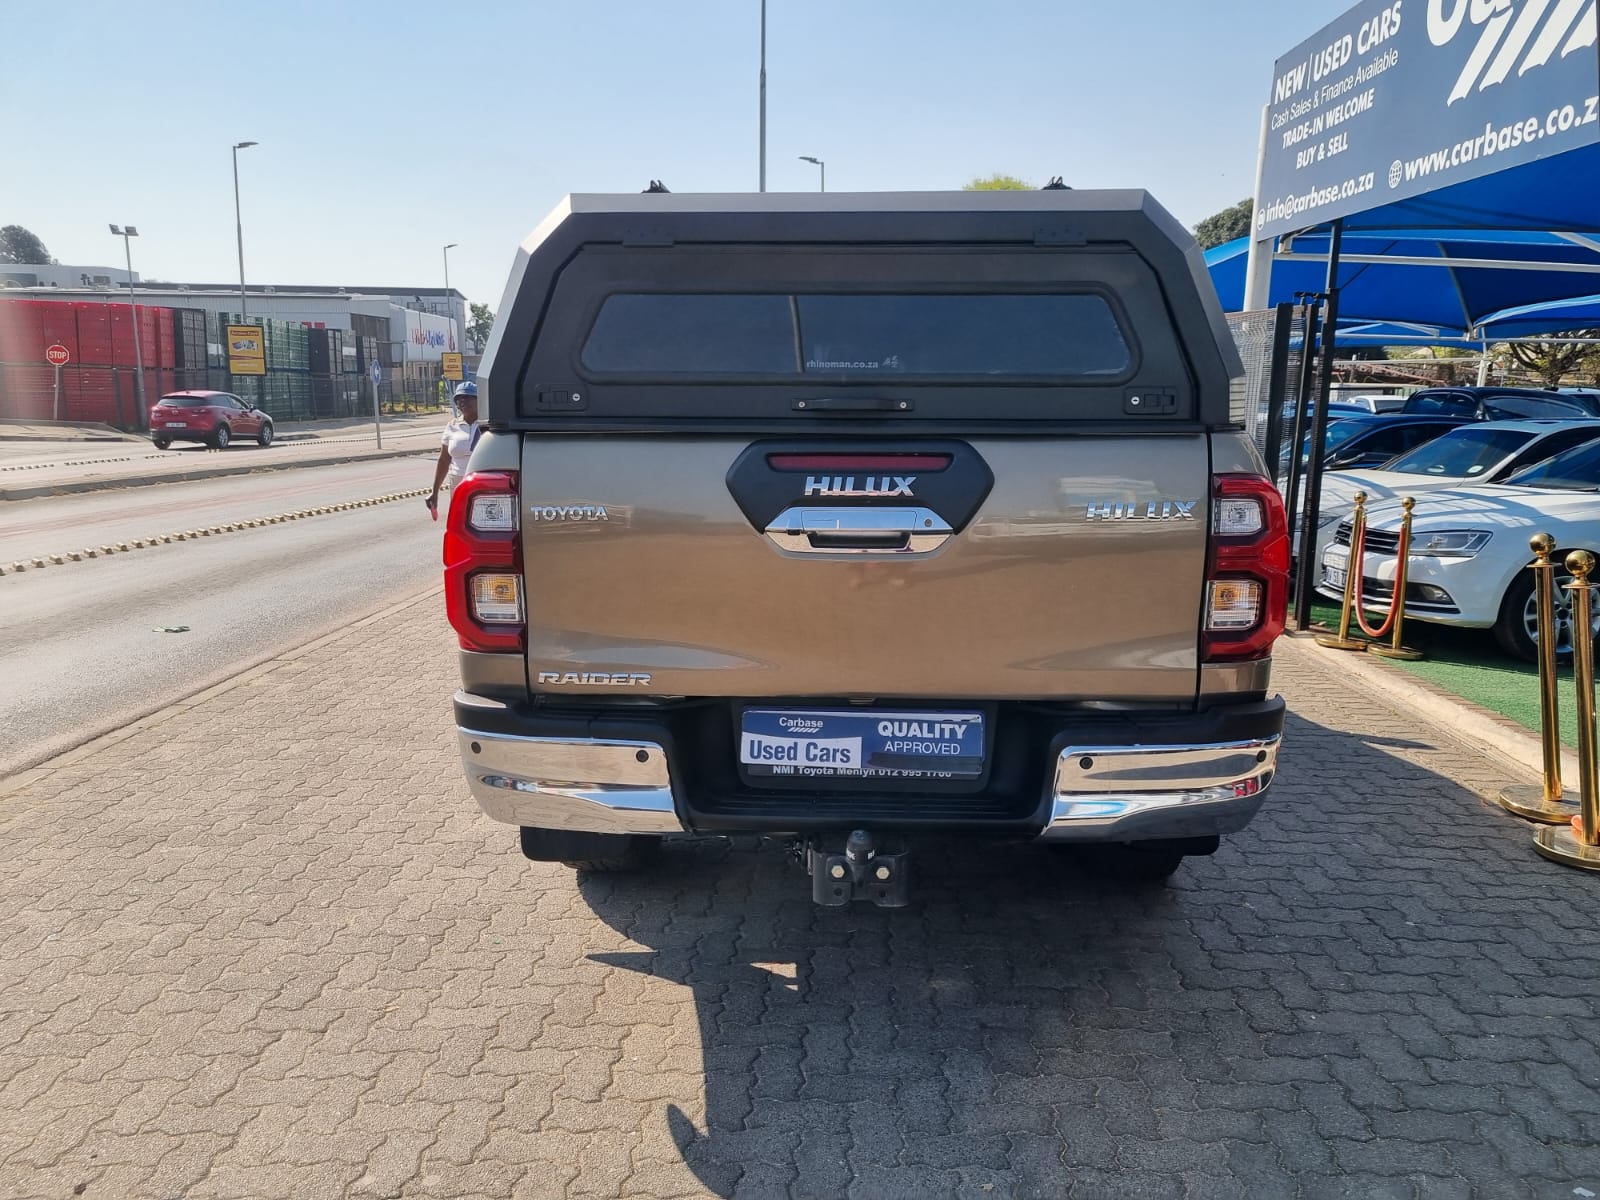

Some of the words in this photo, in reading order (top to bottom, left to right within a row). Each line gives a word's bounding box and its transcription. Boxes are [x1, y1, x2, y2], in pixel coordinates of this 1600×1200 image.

[1275, 62, 1307, 104] NEW
[1313, 34, 1353, 82] USED
[1357, 1, 1402, 55] CARS
[1271, 109, 1289, 130] Cash
[1290, 98, 1312, 120] Sales
[1313, 90, 1319, 109] &
[1321, 75, 1354, 104] Finance
[1354, 47, 1399, 87] Available
[1282, 114, 1324, 149] TRADE-IN
[1326, 88, 1375, 129] WELCOME
[1296, 145, 1317, 169] BUY
[1317, 142, 1325, 161] &
[1327, 132, 1348, 157] SELL
[1266, 172, 1375, 222] info@carbase.co.za
[49, 350, 66, 359] STOP
[806, 359, 879, 369] rhinoman.co.za
[803, 476, 917, 497] HILUX
[530, 505, 609, 521] TOYOTA
[1085, 501, 1197, 521] HILUX
[537, 671, 653, 687] RAIDER
[779, 717, 824, 728] Carbase
[878, 721, 968, 739] QUALITY
[750, 739, 798, 761] Used
[805, 741, 851, 764] Cars
[884, 741, 961, 755] APPROVED
[772, 765, 795, 774] NMI
[797, 766, 834, 777] Toyota
[837, 767, 876, 777] Menlyn
